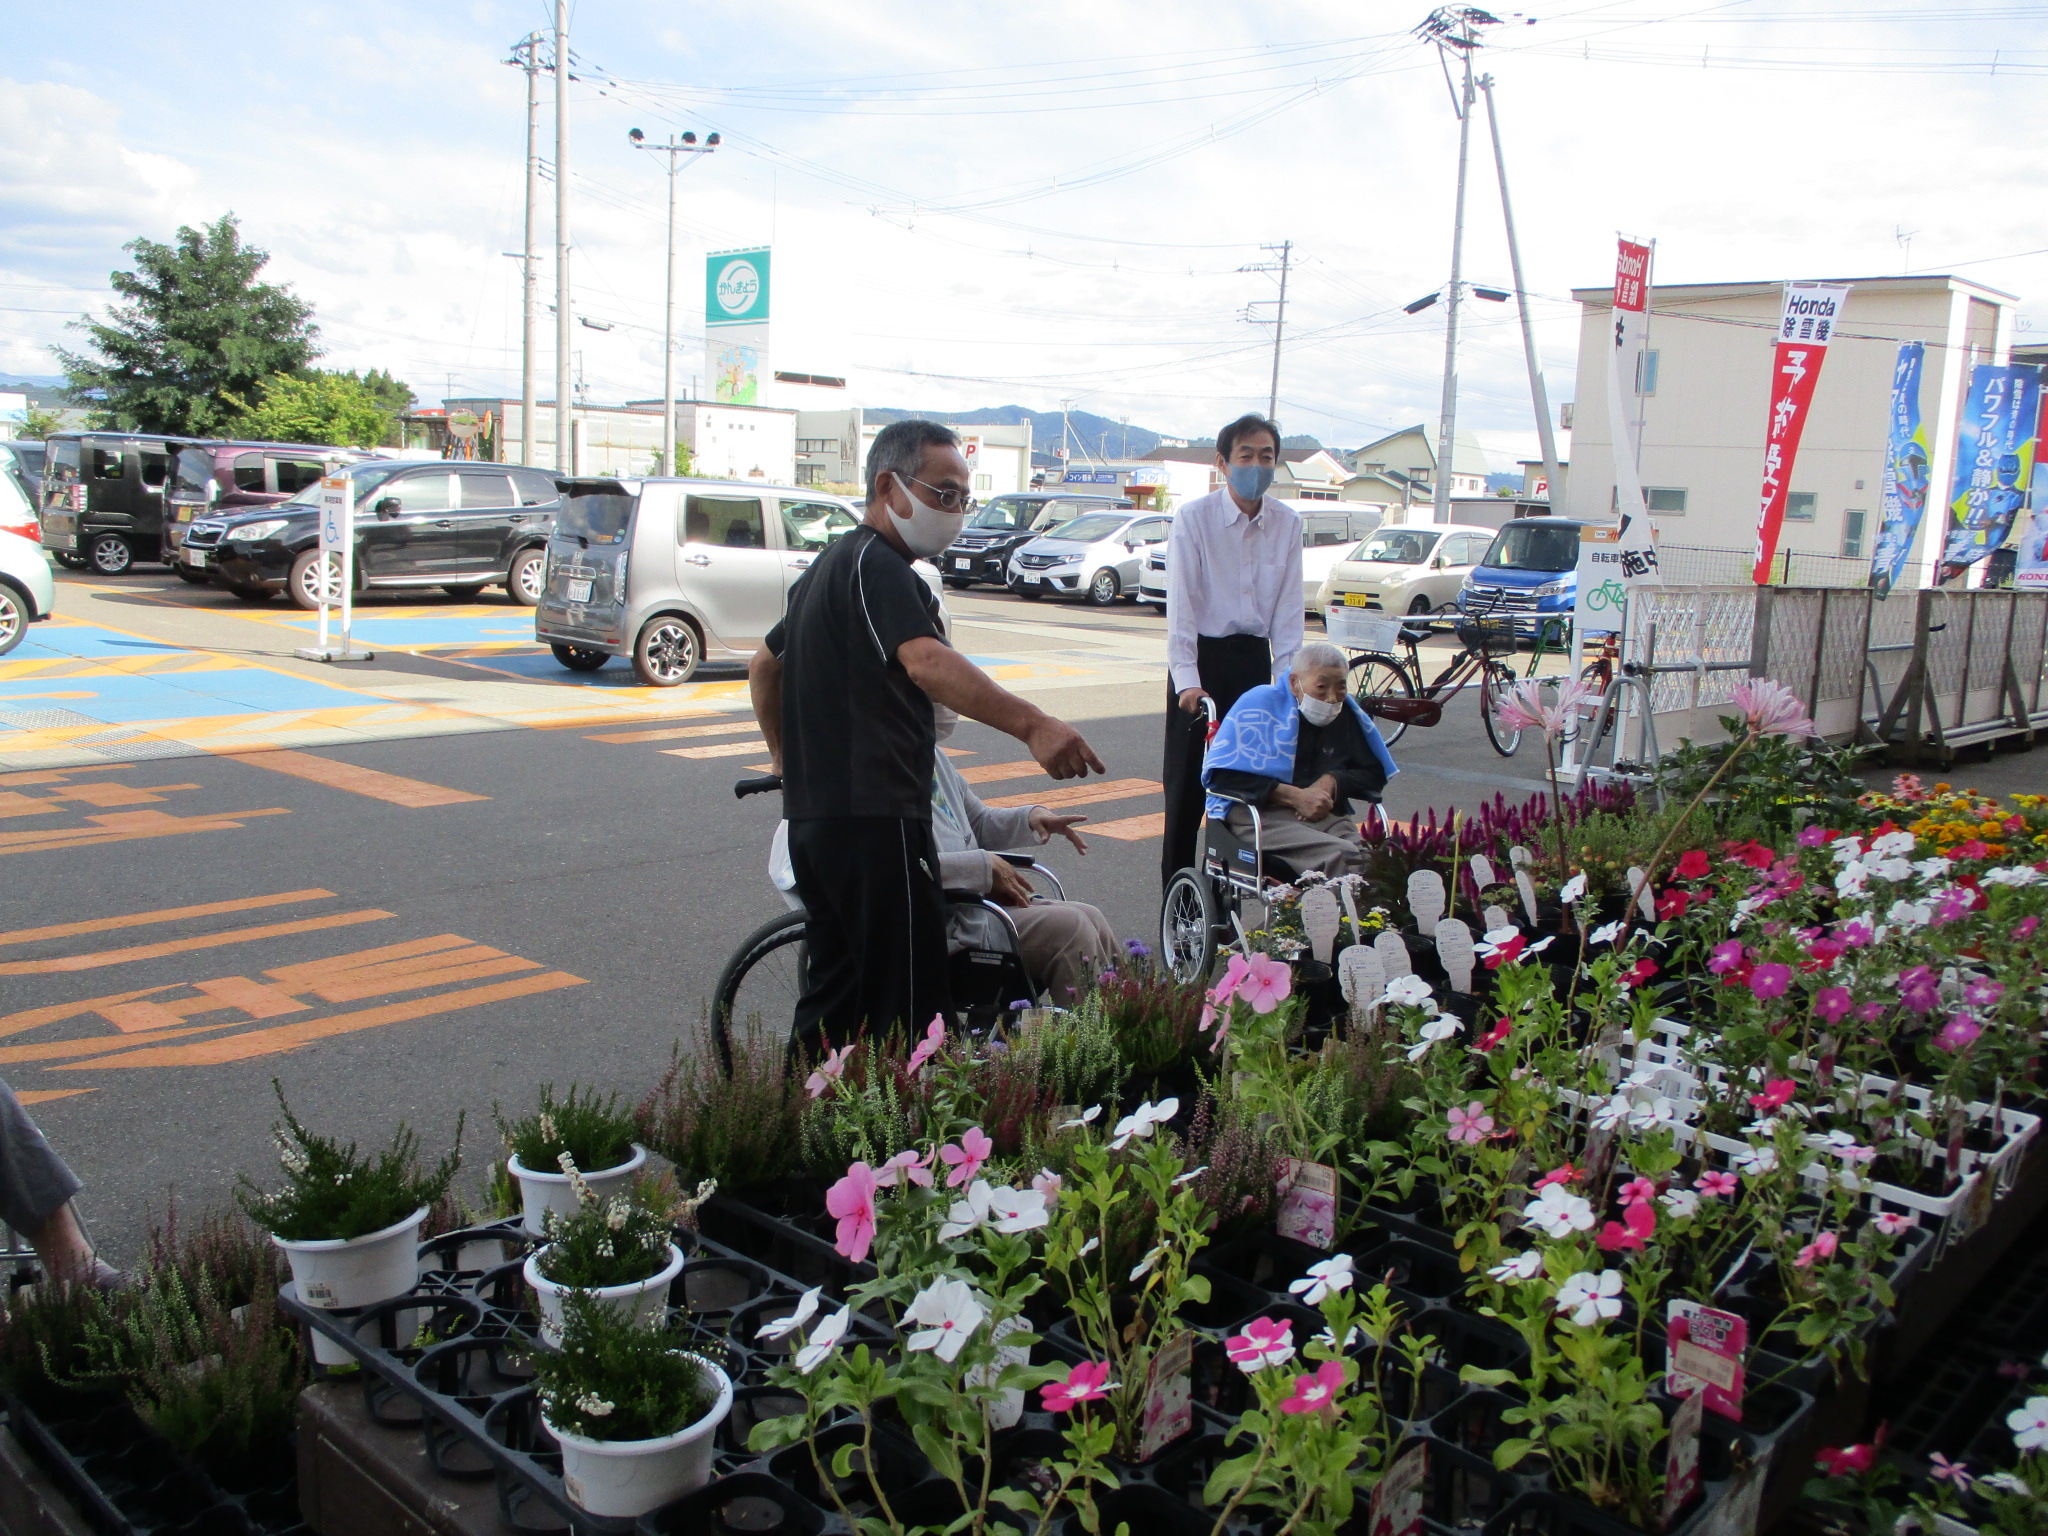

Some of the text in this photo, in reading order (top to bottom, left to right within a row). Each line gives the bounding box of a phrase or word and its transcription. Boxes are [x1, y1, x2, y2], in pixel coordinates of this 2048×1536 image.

[718, 279, 757, 296] かんきょう
[1787, 295, 1836, 317] Honda
[1782, 317, 1831, 342] 除雪機
[965, 444, 977, 460] P
[1535, 482, 1548, 495] P
